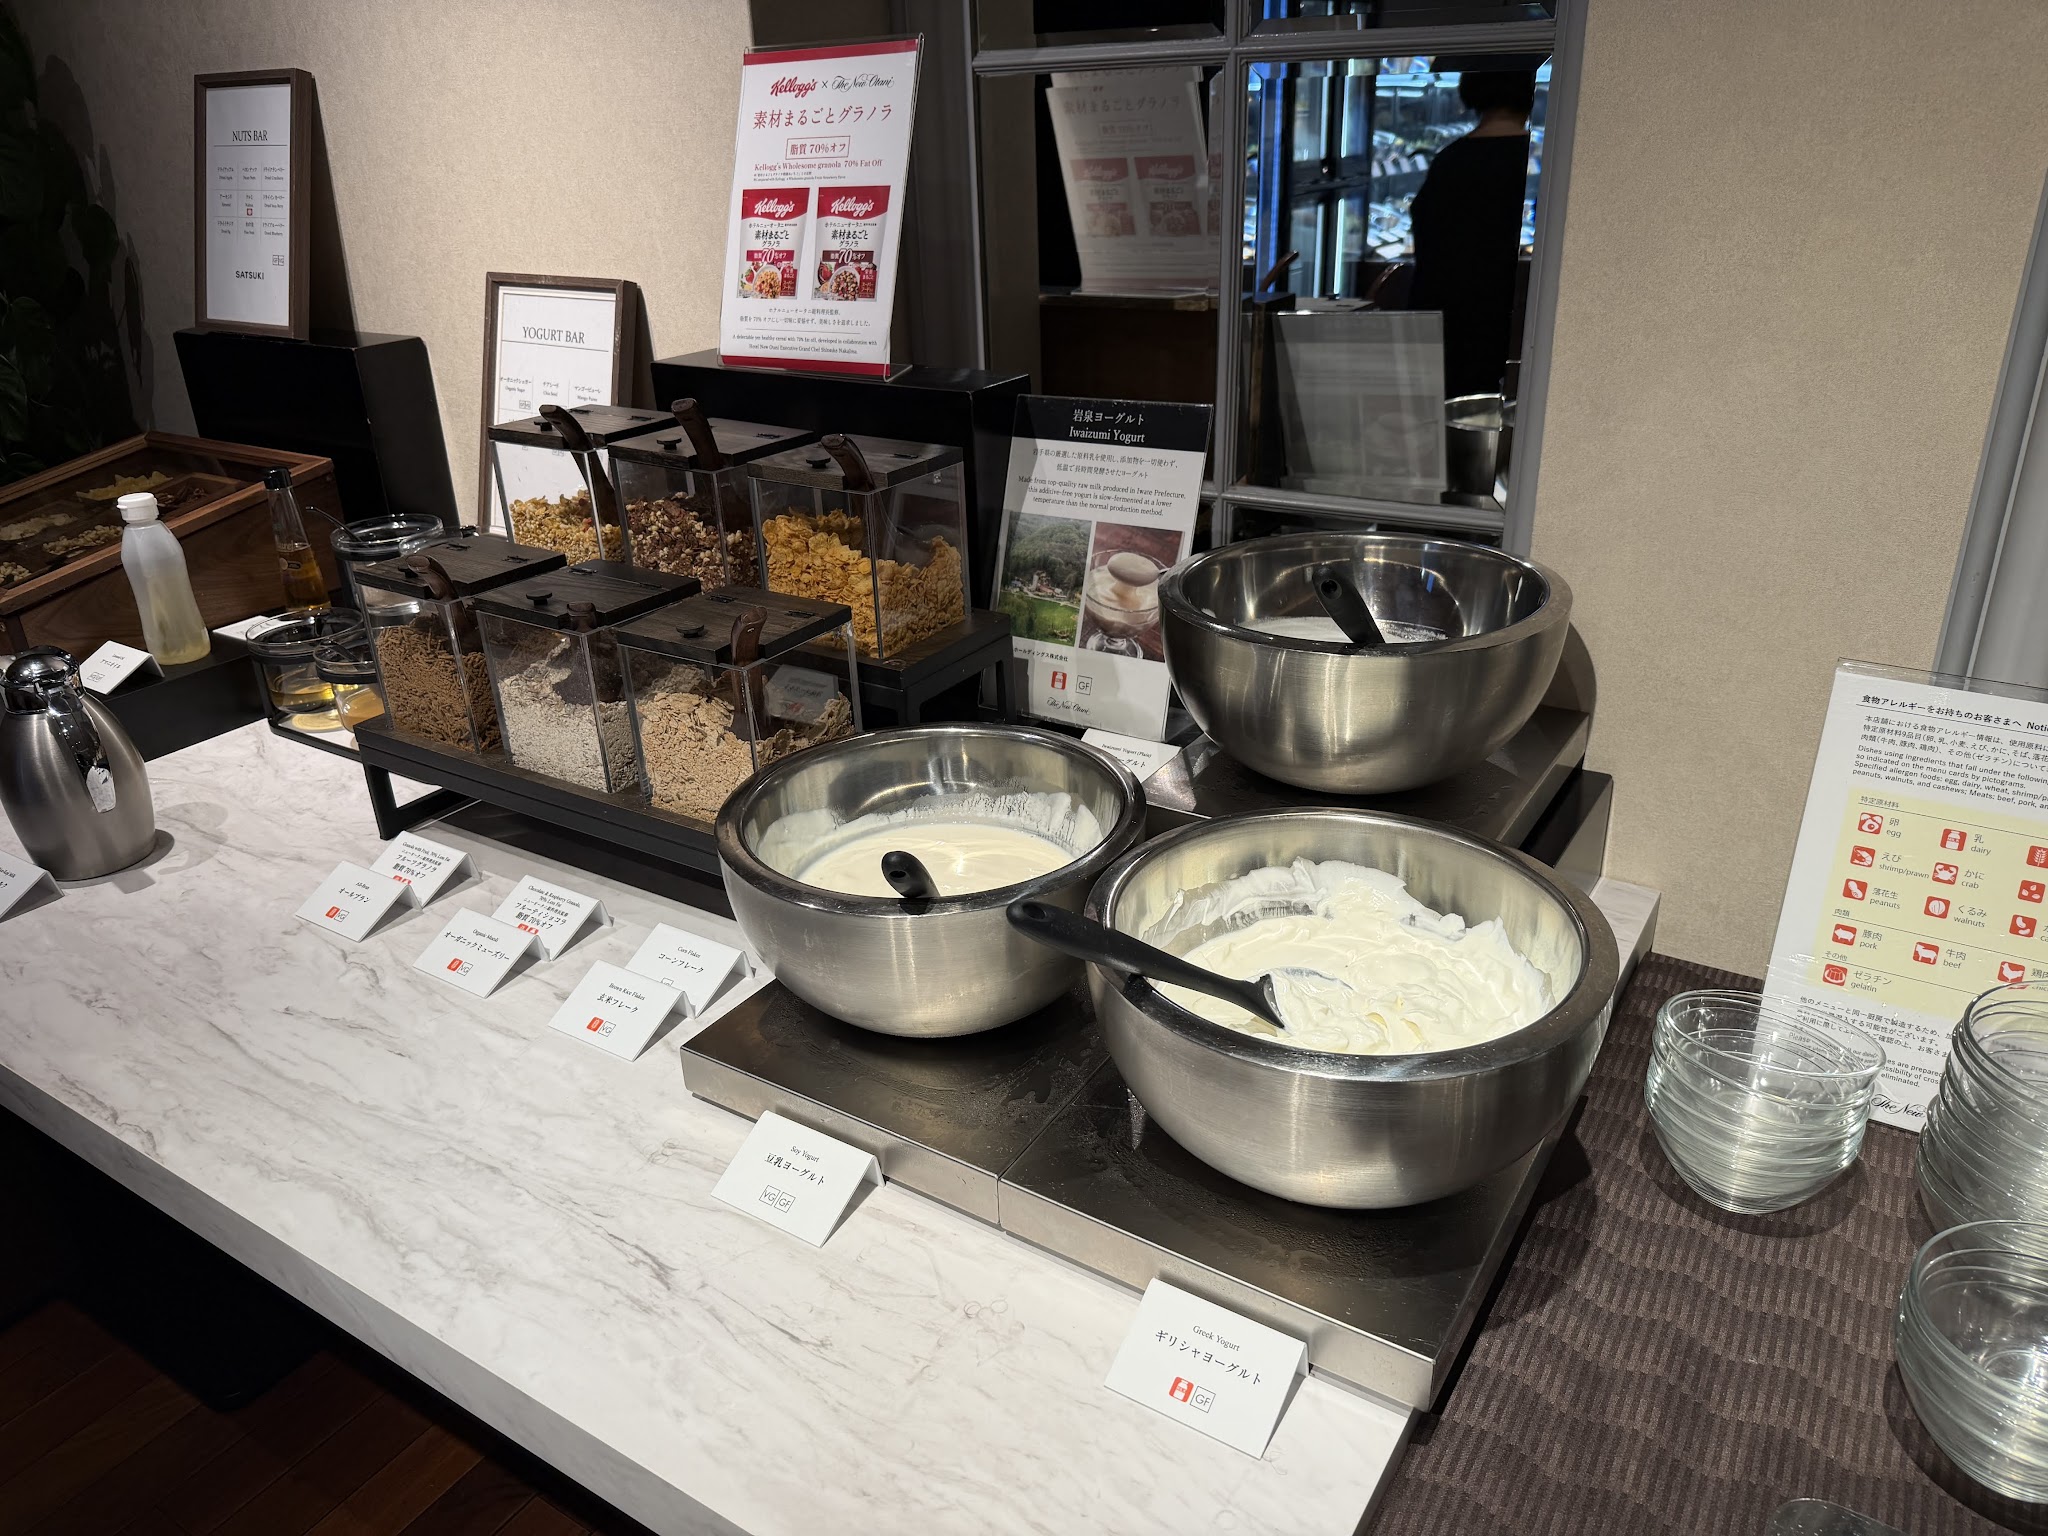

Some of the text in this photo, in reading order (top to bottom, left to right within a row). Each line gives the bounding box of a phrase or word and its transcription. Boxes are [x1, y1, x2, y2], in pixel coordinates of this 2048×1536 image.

[770, 76, 818, 98] Kellogg's
[832, 75, 850, 91] The
[866, 75, 894, 88] Otani
[753, 104, 892, 130] 素材まるごとグラノラ
[232, 130, 268, 142] NUTS BAR
[809, 143, 846, 154] 70%オフ
[754, 162, 780, 172] Kellogg's
[782, 162, 816, 170] Wholesome
[818, 161, 842, 170] granola
[754, 198, 795, 218] Kellogg's
[831, 196, 874, 217] Kellogg's
[754, 230, 790, 240] 素材まるごと
[832, 230, 868, 240] 素材まるごと
[236, 270, 264, 280] SATSUKI
[522, 326, 585, 344] YOGURT BAR
[1072, 409, 1145, 426] 岩泉ヨーグルト
[1068, 426, 1145, 445] Iwaizumi Yogurt
[1048, 479, 1076, 488] top-quality
[1103, 485, 1128, 494] produced
[1136, 488, 1152, 496] Iwate
[1039, 487, 1073, 496] additive-free
[1099, 494, 1143, 505] slow-fermented
[1156, 499, 1172, 507] lower
[1033, 497, 1066, 506] temperature
[1089, 502, 1108, 510] normal
[1110, 504, 1140, 514] production
[1140, 508, 1163, 516] method.
[1014, 647, 1068, 662] ホールディングス株式会社
[1078, 682, 1090, 691] GF
[1862, 694, 2048, 732] 食物アレルギーをお持ちのお客さまへ Noti
[1858, 745, 1882, 754] Dishes
[1884, 750, 1904, 759] using
[1905, 754, 1946, 767] ingredients
[1948, 761, 1963, 769] that
[1965, 763, 1977, 771] fall
[1979, 767, 2001, 776] under
[2003, 771, 2016, 779] the
[1854, 760, 1888, 772] Specified
[1889, 768, 1918, 777] allergen
[1920, 773, 1942, 782] foods:
[1944, 778, 1960, 786] egg,
[1962, 780, 1982, 790] dairy,
[1984, 784, 2010, 795] wheat,
[1866, 754, 1900, 766] indicated
[1948, 770, 1969, 778] cards
[1971, 773, 1980, 781] by
[1982, 776, 2026, 789] pictograms.
[1852, 769, 1882, 780] peanuts,
[1885, 775, 1915, 786] walnuts,
[1932, 783, 1967, 795] cashews;
[1969, 789, 1995, 800] Meats:
[1997, 795, 2016, 804] beef,
[2018, 799, 2037, 808] pork,
[1860, 796, 1899, 808] 特定原材料
[1889, 818, 1900, 826] 卵
[1886, 829, 1901, 838] egg
[1974, 833, 1984, 844] 乳
[1882, 852, 1901, 862] えび
[1971, 845, 1991, 856] dairy
[396, 854, 437, 873] フルーツグラノラ
[1879, 863, 1930, 879] shrimp/prawn
[1964, 869, 1985, 880] かに
[1961, 881, 1979, 889] crab
[338, 888, 370, 903] オールブラン
[1872, 887, 1898, 900] 落花生
[1869, 898, 1901, 910] peanuts
[1958, 904, 1987, 917] くるみ
[515, 902, 567, 926] フルーティショコラ
[1834, 908, 1850, 917] 肉類
[1954, 916, 1985, 928] walnuts
[472, 929, 486, 939] Organic
[1862, 929, 1882, 942] 豚肉
[444, 931, 510, 961] オーガニックミューズリー
[1859, 941, 1878, 950] pork
[687, 950, 701, 958] Flakes
[1825, 951, 1848, 961] その他
[1945, 948, 1967, 961] 牛肉
[459, 965, 470, 974] VG
[658, 953, 704, 973] コーンフレーク
[1942, 959, 1962, 969] beef
[1853, 970, 1892, 985] ゼラチン
[608, 982, 646, 1001] Brown Rice Flakes
[1850, 981, 1878, 993] gelatin
[597, 993, 639, 1014] 玄米フレーク
[602, 1026, 612, 1034] VG
[1880, 1065, 1912, 1078] ossibility
[1881, 1073, 1920, 1087] eliminated.
[1871, 1094, 1927, 1118] The New
[790, 1145, 820, 1163] Soy Yogurt
[764, 1152, 825, 1186] 豆乳ヨーグルト
[764, 1190, 791, 1208] VG GF
[1192, 1325, 1240, 1352] Greek Yogurt
[1156, 1330, 1261, 1385] ギリシャヨーグルト
[1194, 1394, 1210, 1406] GF
